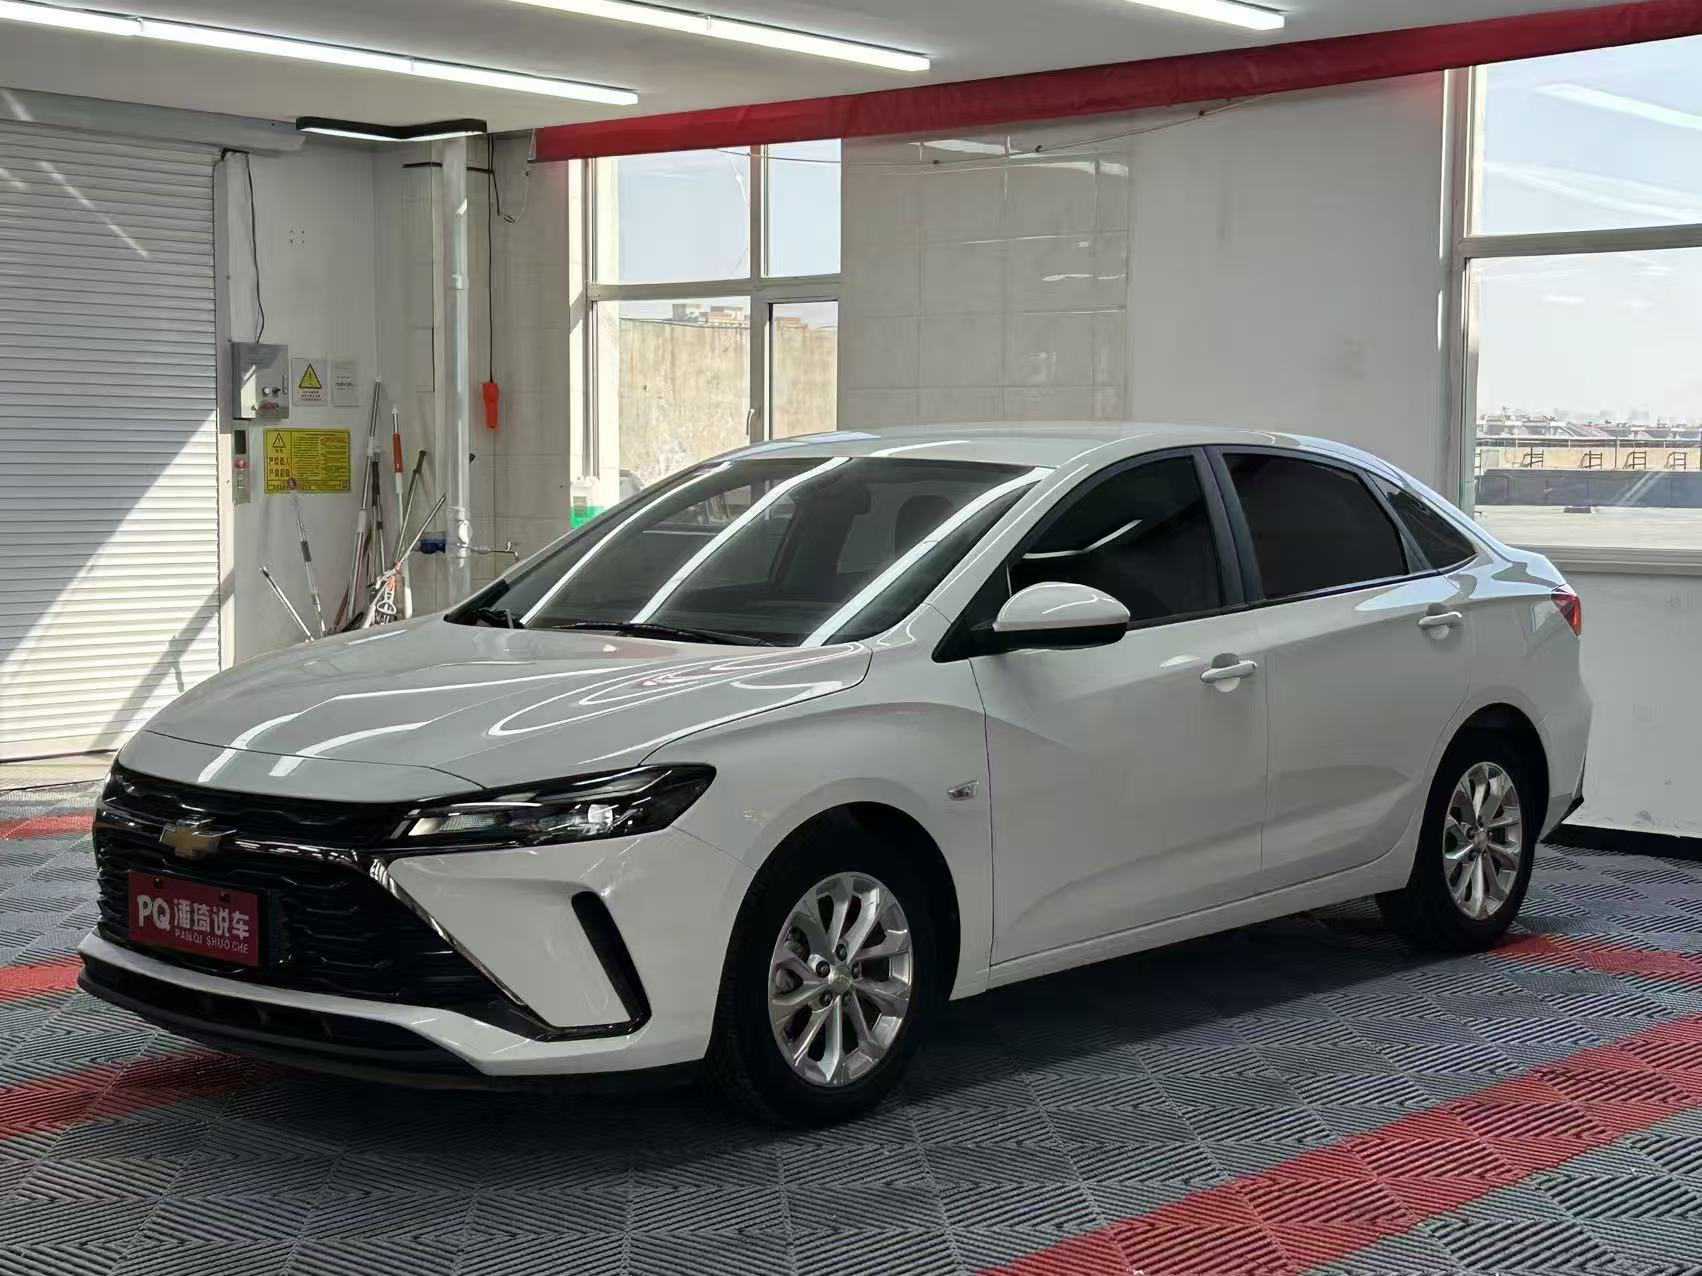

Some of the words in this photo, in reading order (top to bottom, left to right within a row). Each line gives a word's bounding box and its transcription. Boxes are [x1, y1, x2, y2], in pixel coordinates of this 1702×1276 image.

[136, 894, 171, 932] PQ
[206, 935, 231, 950] SHUO
[231, 940, 249, 954] CHE
